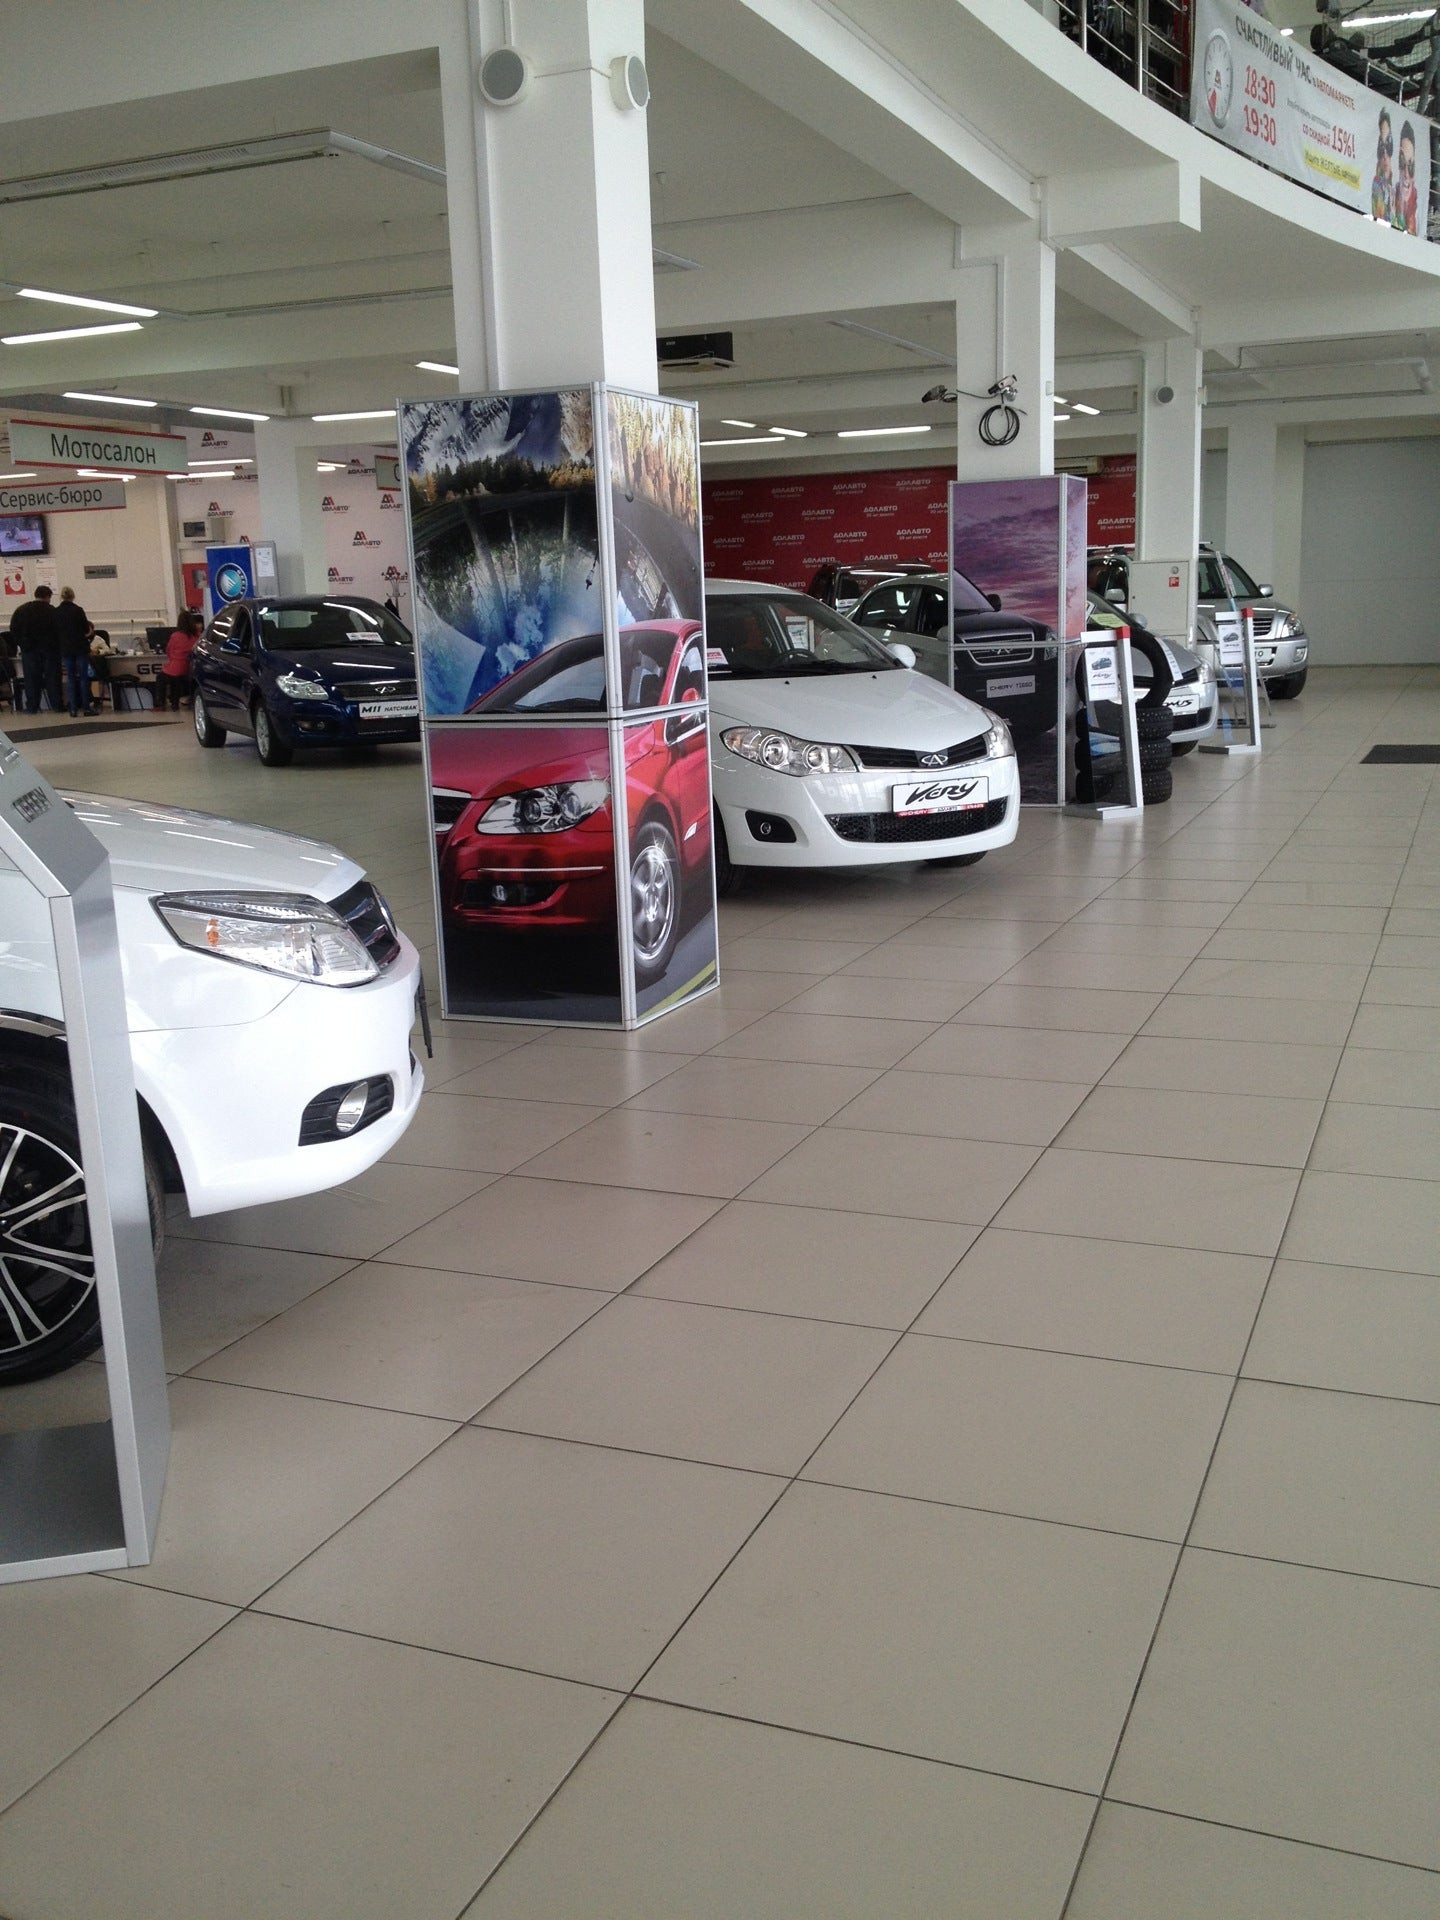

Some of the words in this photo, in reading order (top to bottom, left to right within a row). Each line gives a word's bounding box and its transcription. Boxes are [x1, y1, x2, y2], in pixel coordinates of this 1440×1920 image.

[1236, 15, 1293, 72] СЧАСТЛИВЫЙ
[1295, 55, 1312, 85] ЧАС
[1244, 64, 1276, 108] 18:30
[1243, 104, 1277, 146] 19:30
[1332, 125, 1356, 159] 15%!
[51, 433, 157, 464] Мотосалон
[0, 486, 103, 510] Сервис-бюро
[928, 502, 948, 510] ДОЛА
[928, 551, 948, 560] ДОЛА
